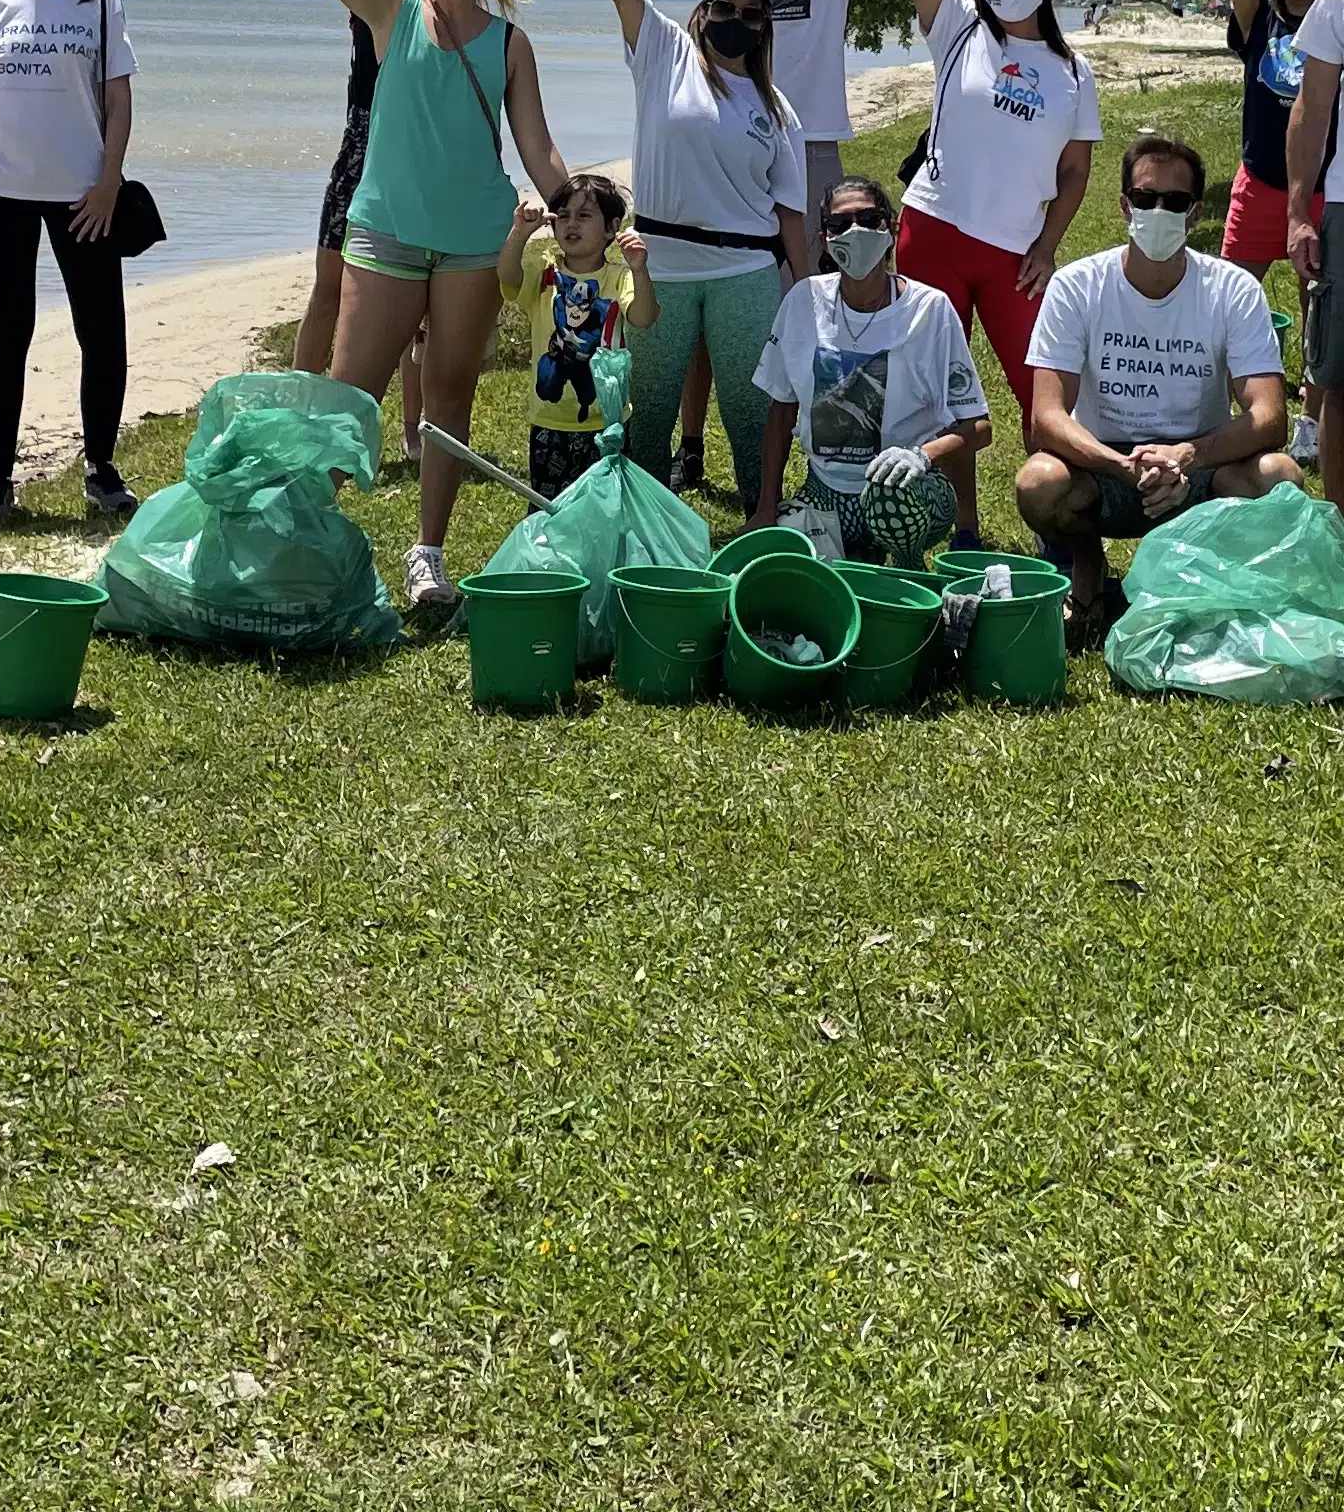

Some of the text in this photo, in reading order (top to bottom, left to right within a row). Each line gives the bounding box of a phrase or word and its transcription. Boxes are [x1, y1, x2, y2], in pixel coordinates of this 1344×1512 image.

[1, 23, 94, 39] PRAIA LIMPA
[11, 43, 58, 55] PRAIA
[992, 79, 1044, 109] LAGOA
[994, 94, 1036, 121] VIVA!
[1103, 332, 1206, 355] PRAIA LIMPA
[1101, 353, 1213, 378] É PRAIA MAIS
[1099, 381, 1159, 398] BONITA
